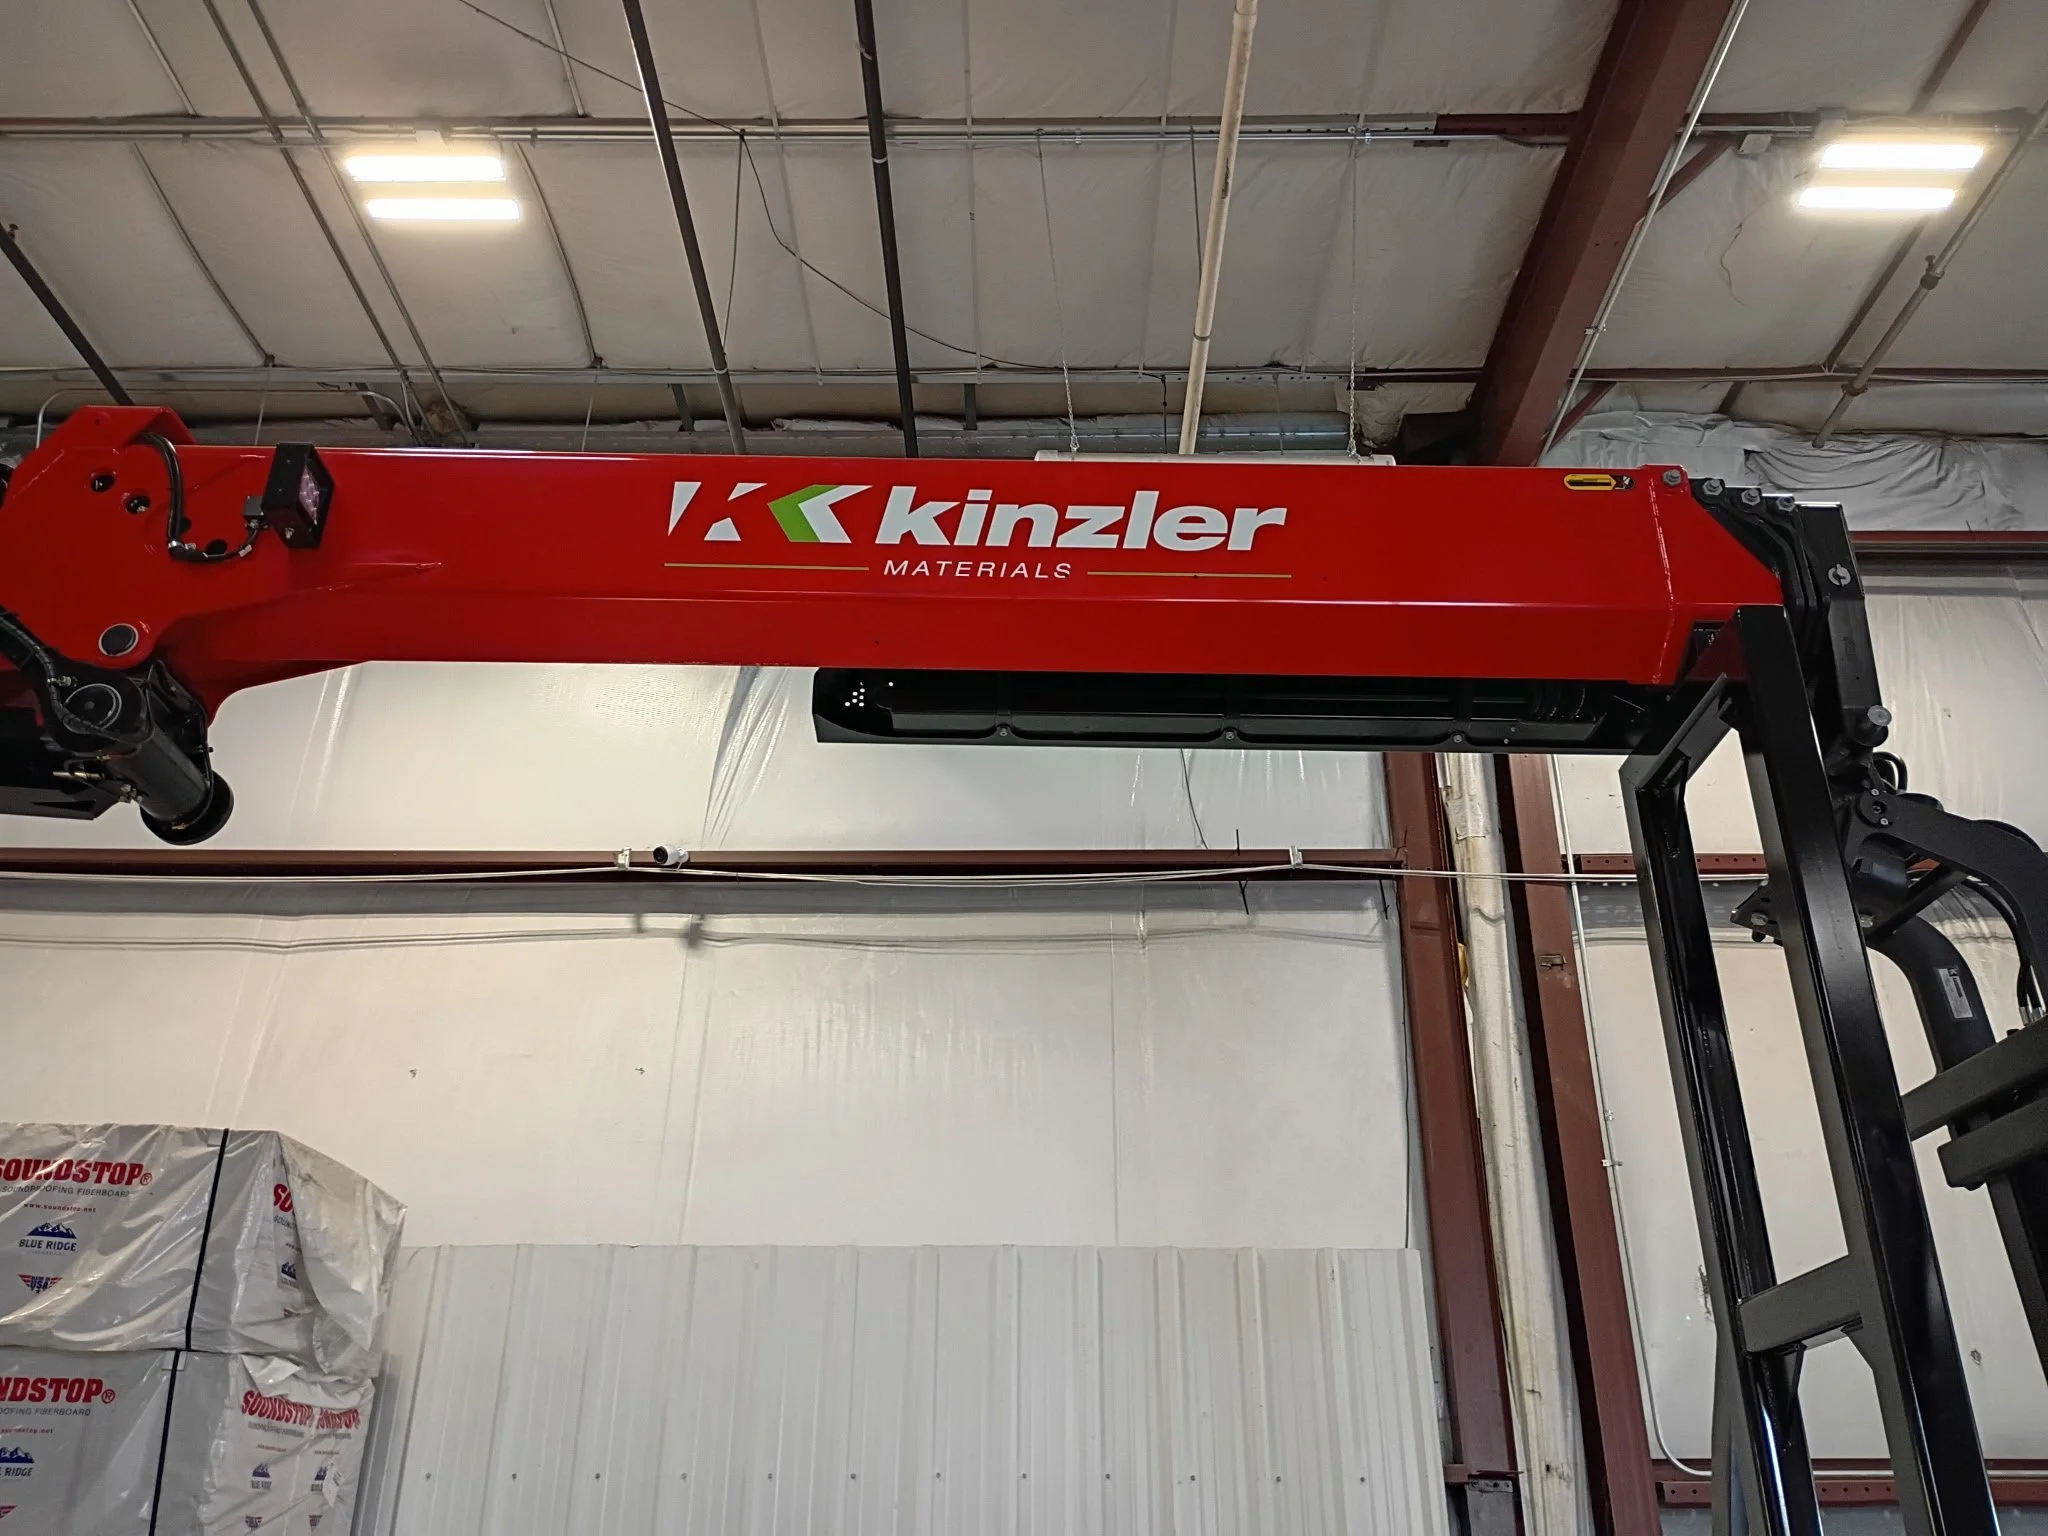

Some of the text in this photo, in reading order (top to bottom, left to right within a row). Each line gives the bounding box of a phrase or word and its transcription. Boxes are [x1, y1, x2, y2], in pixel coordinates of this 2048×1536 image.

[874, 484, 1288, 552] kinzler
[883, 559, 1073, 580] MATERIALS
[19, 1239, 77, 1252] BLUE RIDGE
[30, 1280, 49, 1291] USA
[4, 1467, 34, 1477] RIDGE
